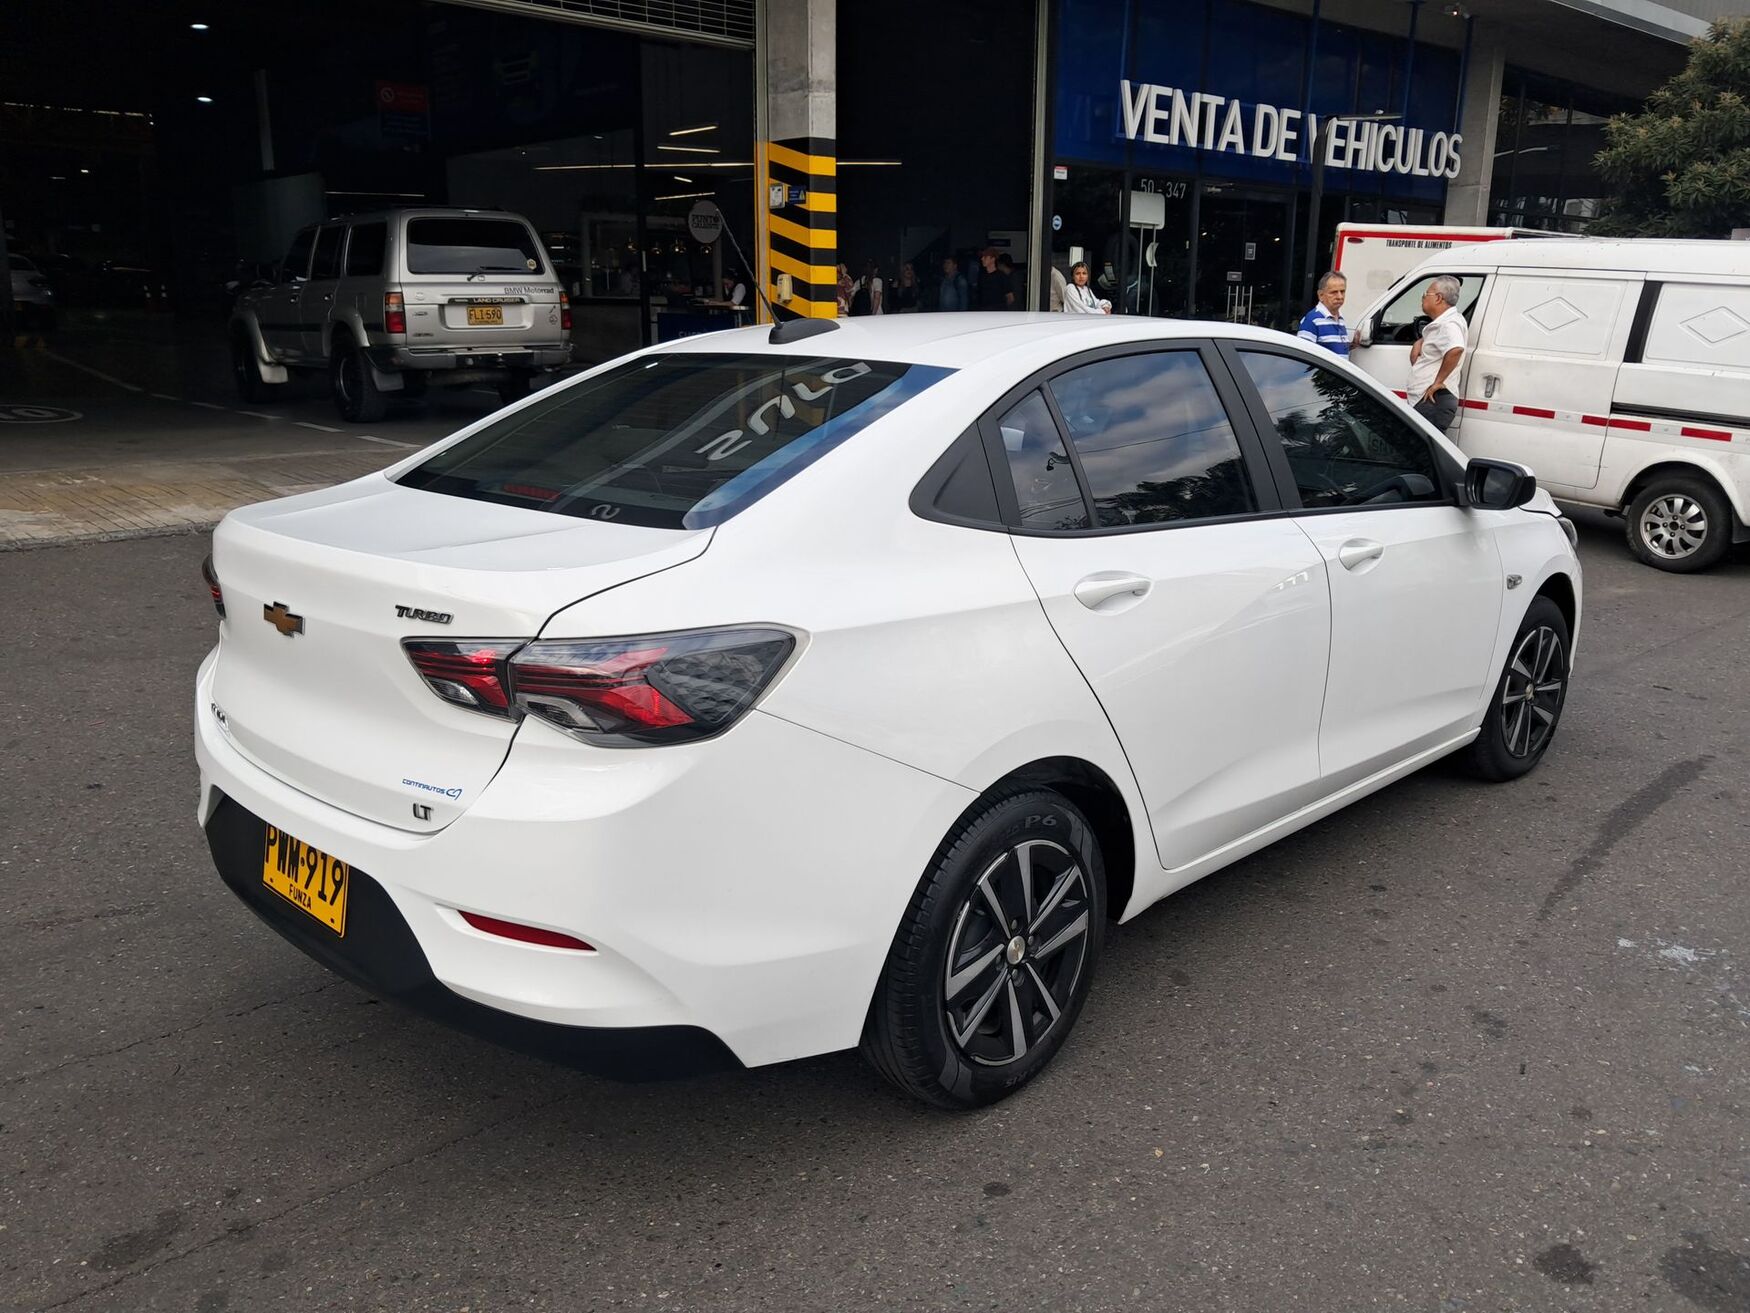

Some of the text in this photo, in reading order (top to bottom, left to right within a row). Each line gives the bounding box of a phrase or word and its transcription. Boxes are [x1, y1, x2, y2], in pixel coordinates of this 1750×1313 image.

[1120, 80, 1245, 154] VENTA
[1252, 103, 1302, 161] DE
[1386, 239, 1452, 249] TRANSPORTE DE ALIMENTOS
[504, 287, 523, 295] BMW
[395, 604, 455, 625] TURBO
[413, 802, 434, 821] LT
[288, 883, 312, 910] FUNZA
